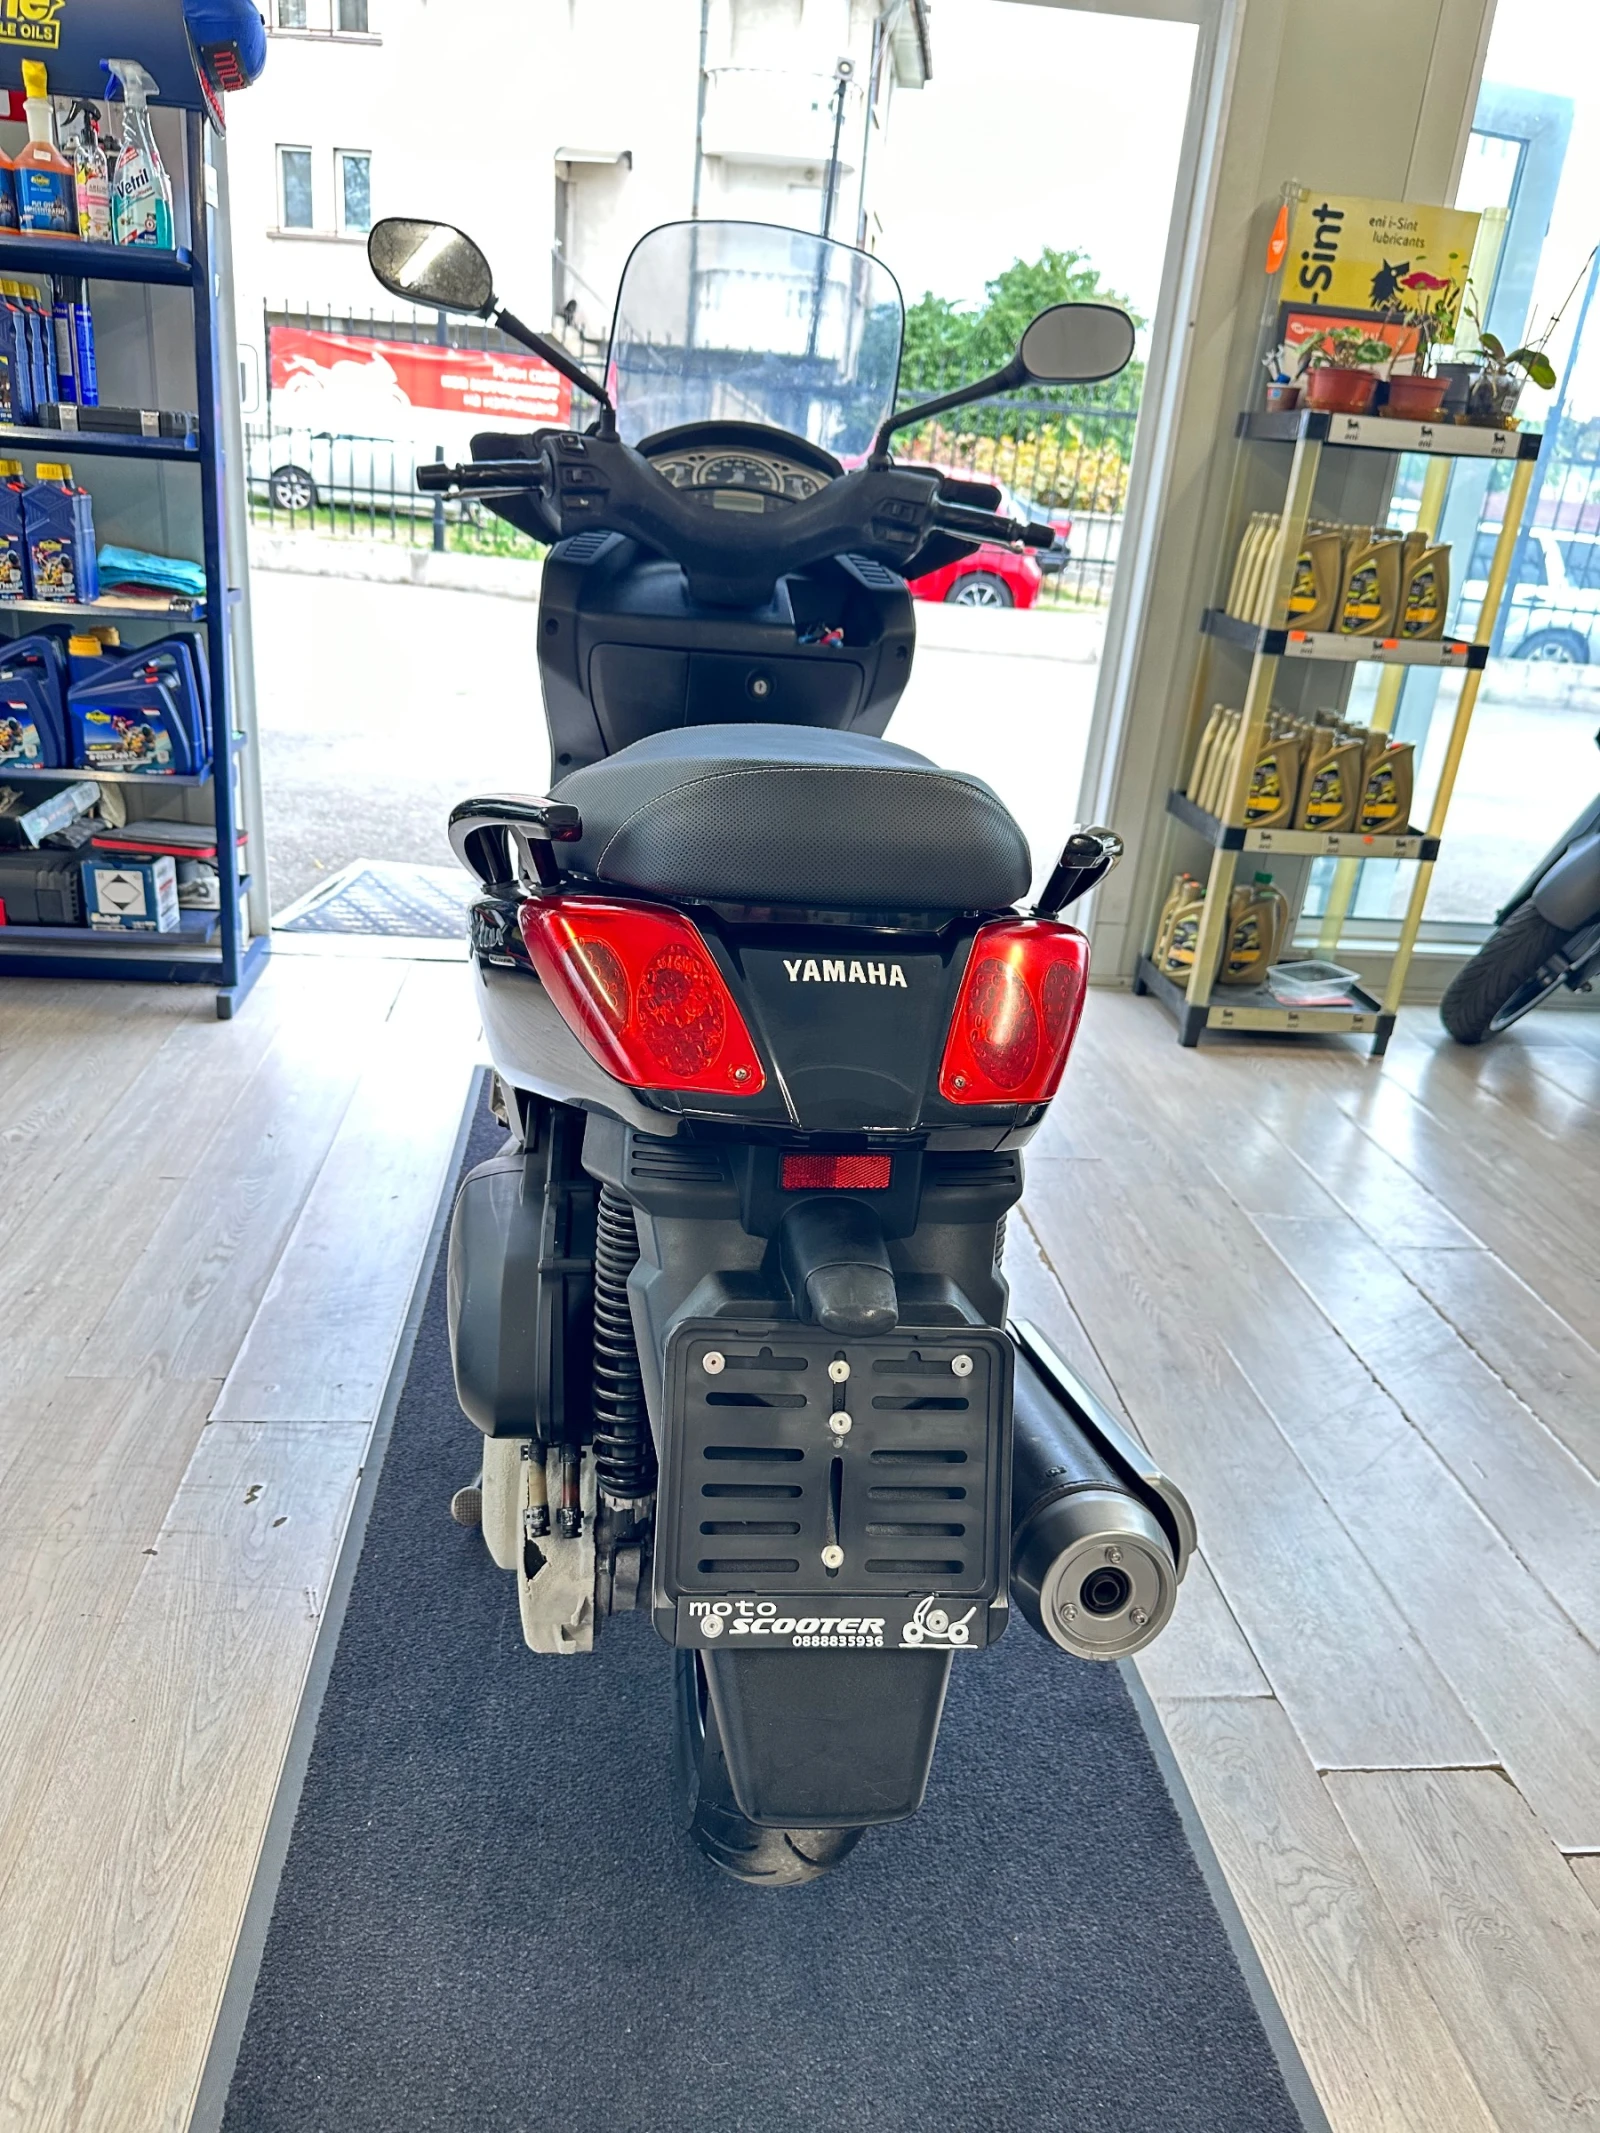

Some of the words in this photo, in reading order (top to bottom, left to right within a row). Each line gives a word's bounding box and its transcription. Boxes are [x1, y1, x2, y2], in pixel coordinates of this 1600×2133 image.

[20, 24, 53, 40] OILS
[116, 168, 149, 199] Vetril
[1368, 214, 1387, 228] eni
[1388, 215, 1419, 232] i-Sint
[1372, 230, 1426, 249] lubricants
[782, 959, 908, 988] YAMAHA
[688, 1600, 777, 1617] moto
[728, 1617, 886, 1635] SCOOTER
[792, 1635, 884, 1648] 0888835936
